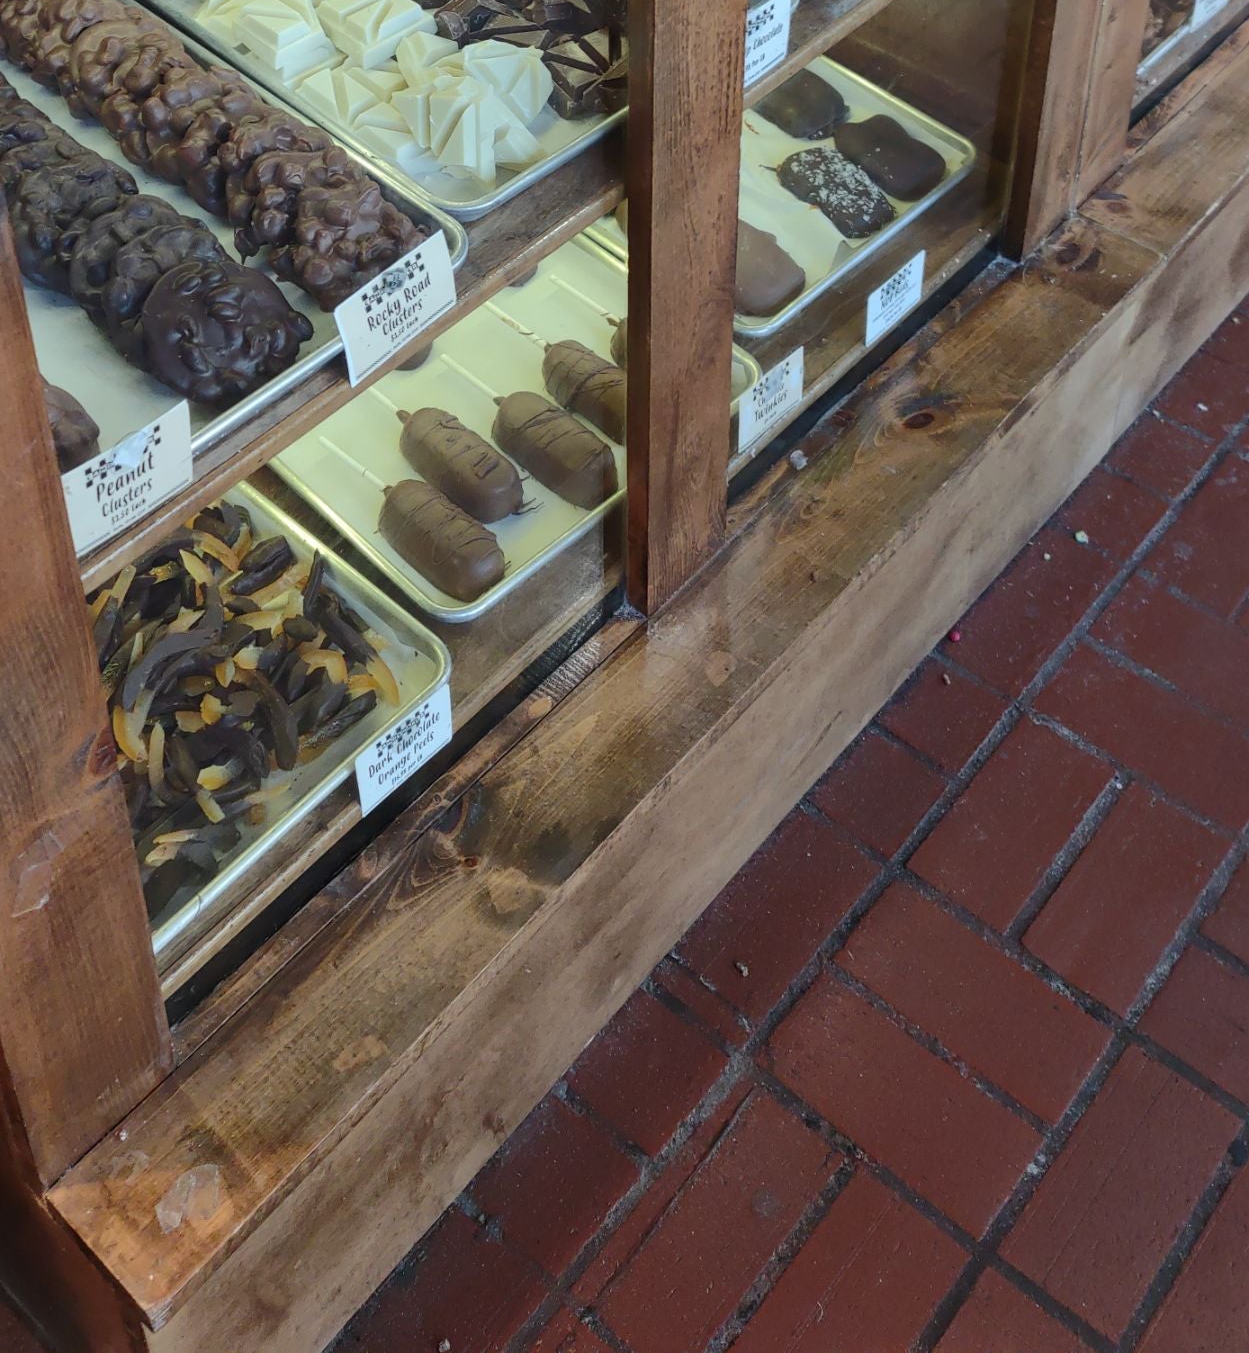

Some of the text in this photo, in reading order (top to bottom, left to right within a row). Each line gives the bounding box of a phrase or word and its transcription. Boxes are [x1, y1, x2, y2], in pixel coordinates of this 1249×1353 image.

[367, 272, 432, 331] Rocky Road
[382, 298, 423, 335] Clusters
[96, 451, 155, 503] Peanut
[102, 478, 152, 517] Clusters
[368, 751, 393, 779] Dark
[397, 711, 440, 755] Chocolate
[378, 752, 411, 785] Orange
[413, 731, 434, 755] Peels
